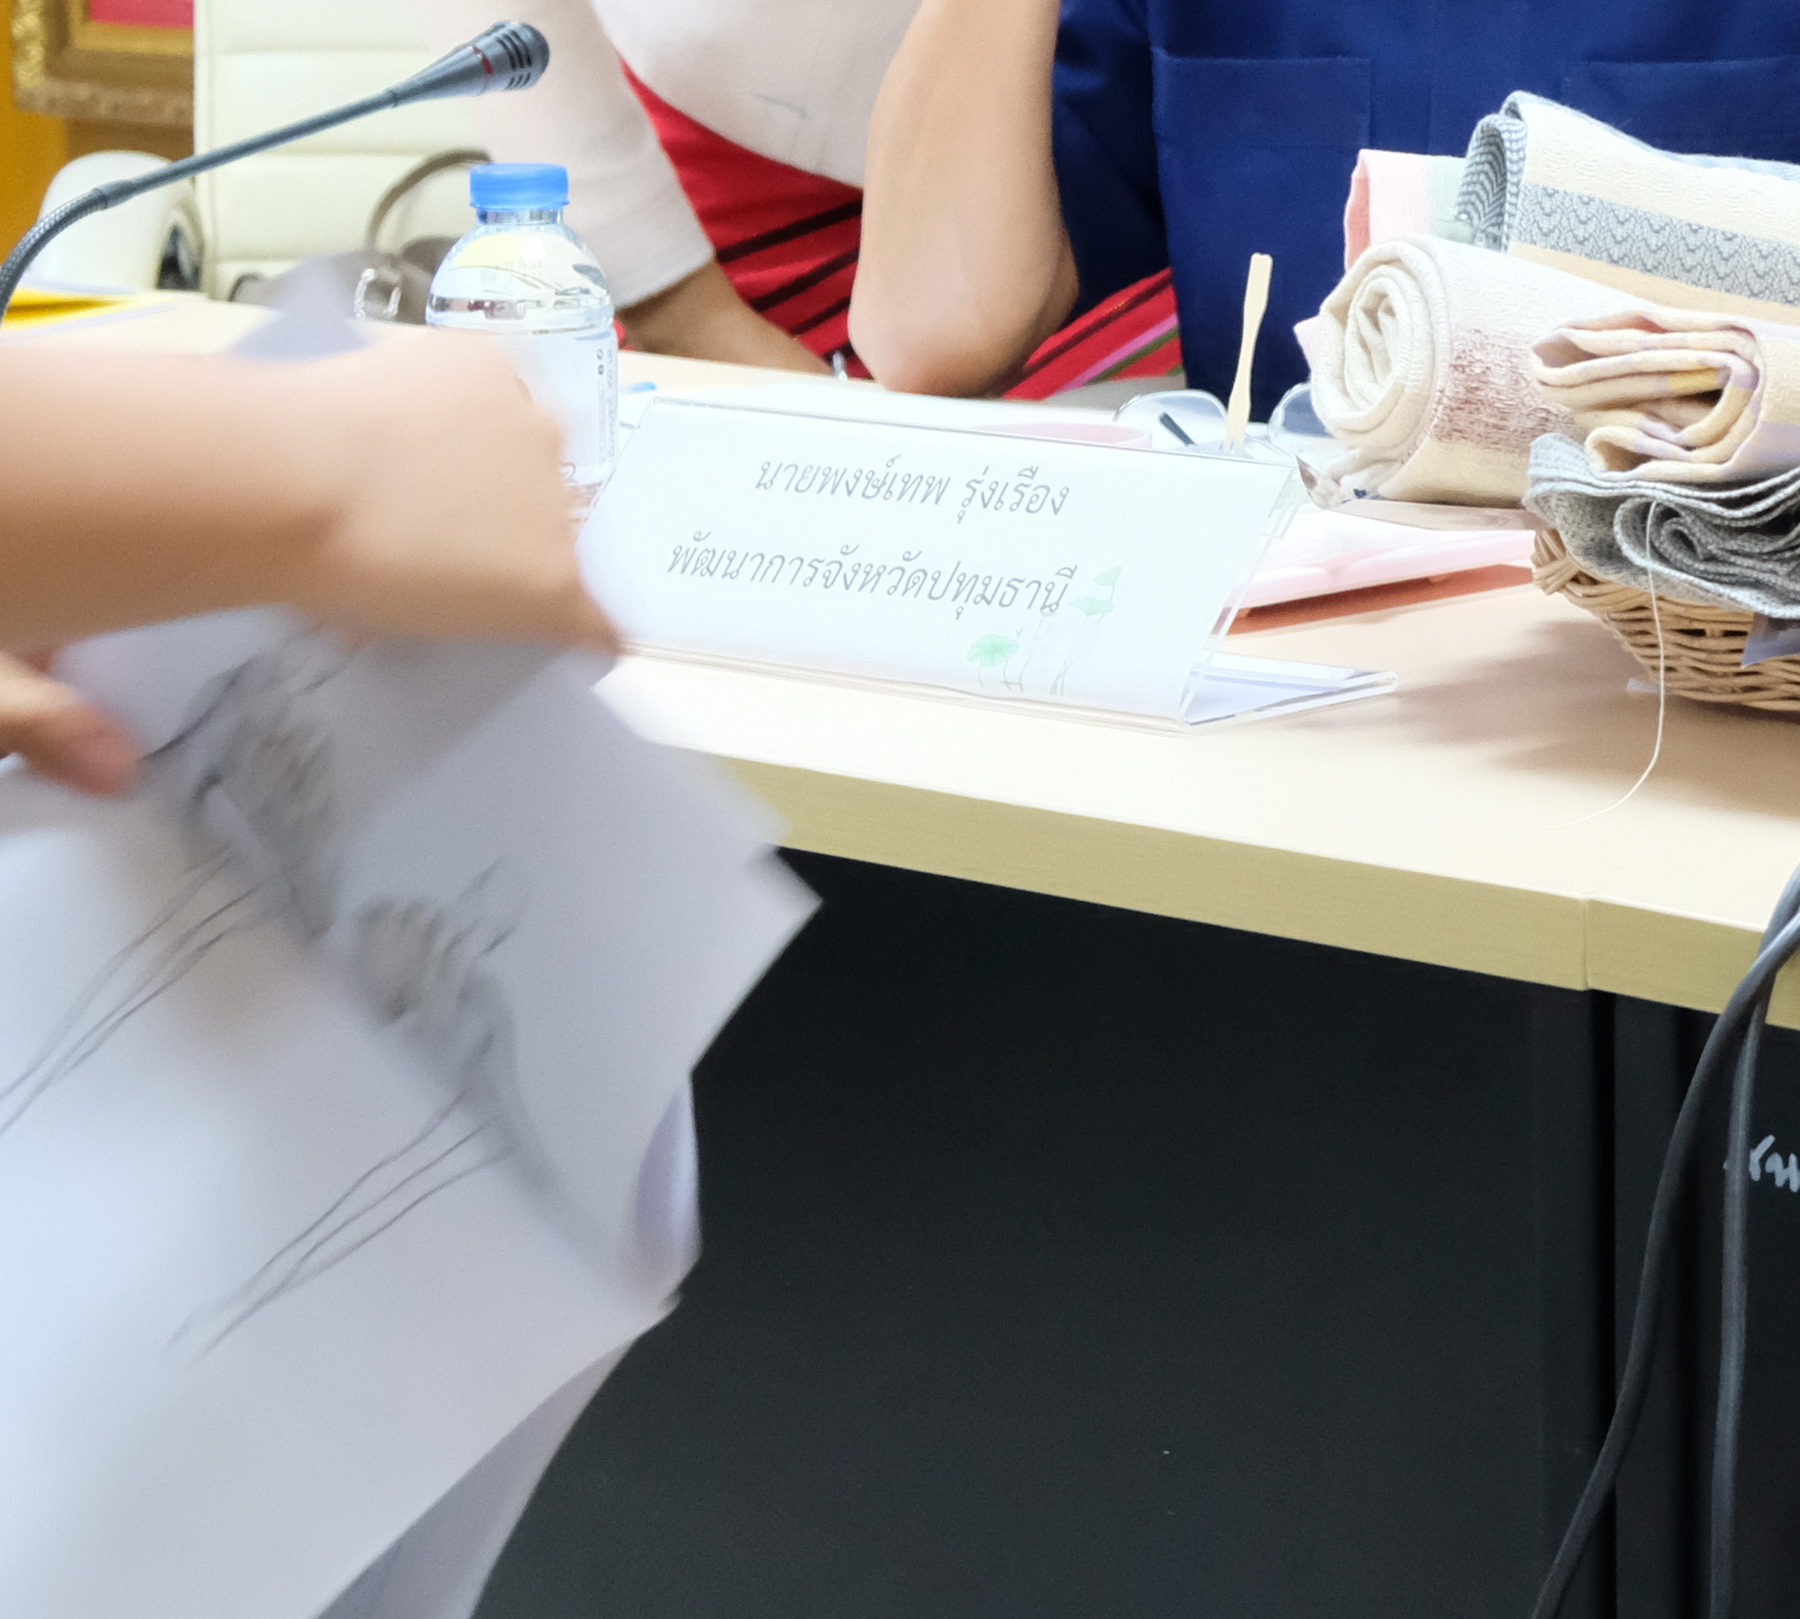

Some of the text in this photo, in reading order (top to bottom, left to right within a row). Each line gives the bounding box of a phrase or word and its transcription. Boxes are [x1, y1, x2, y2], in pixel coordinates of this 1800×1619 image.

[754, 453, 1070, 524] นายพงษ์เทพ รุ่งเรือง
[666, 530, 1079, 620] พัฒนาการจังหวัดปทุมธานี
